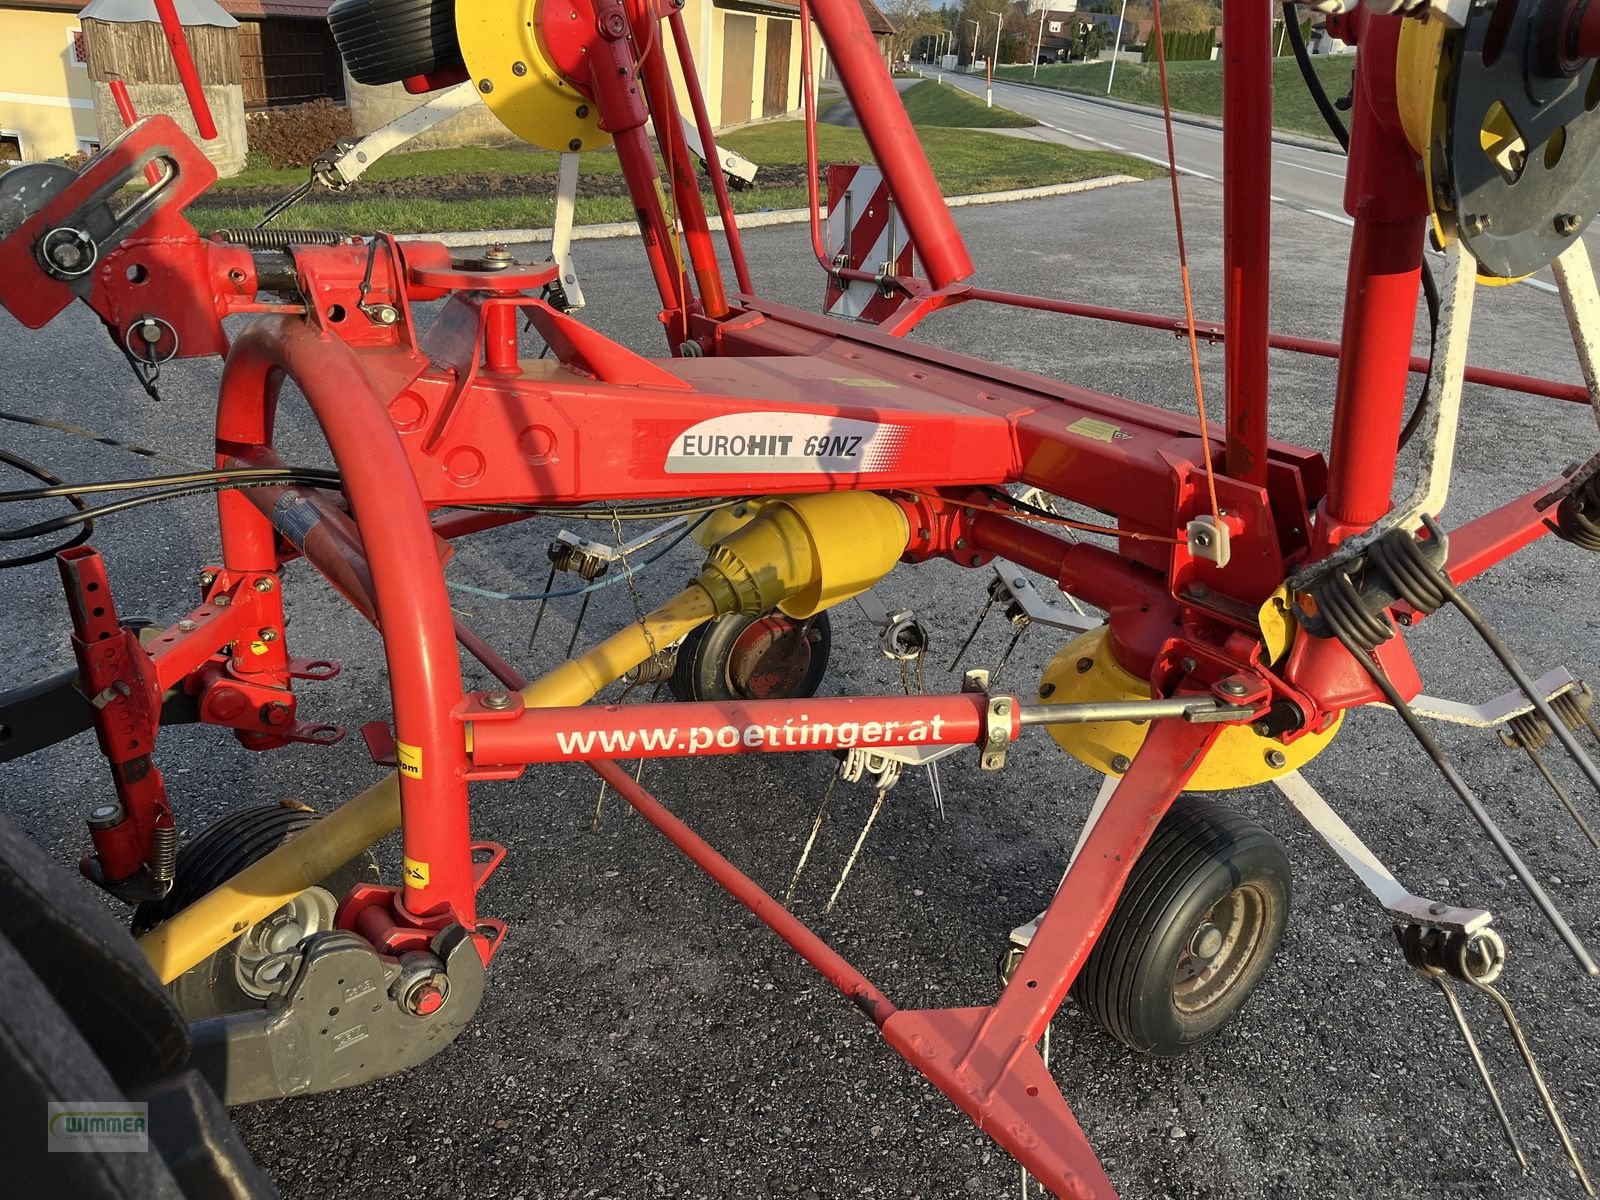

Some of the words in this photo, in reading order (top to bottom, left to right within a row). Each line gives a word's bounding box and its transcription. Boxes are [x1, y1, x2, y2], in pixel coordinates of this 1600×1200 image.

[683, 435, 792, 457] EUROHIT
[803, 435, 862, 457] 69NZ
[556, 714, 945, 754] www.poettinger.at
